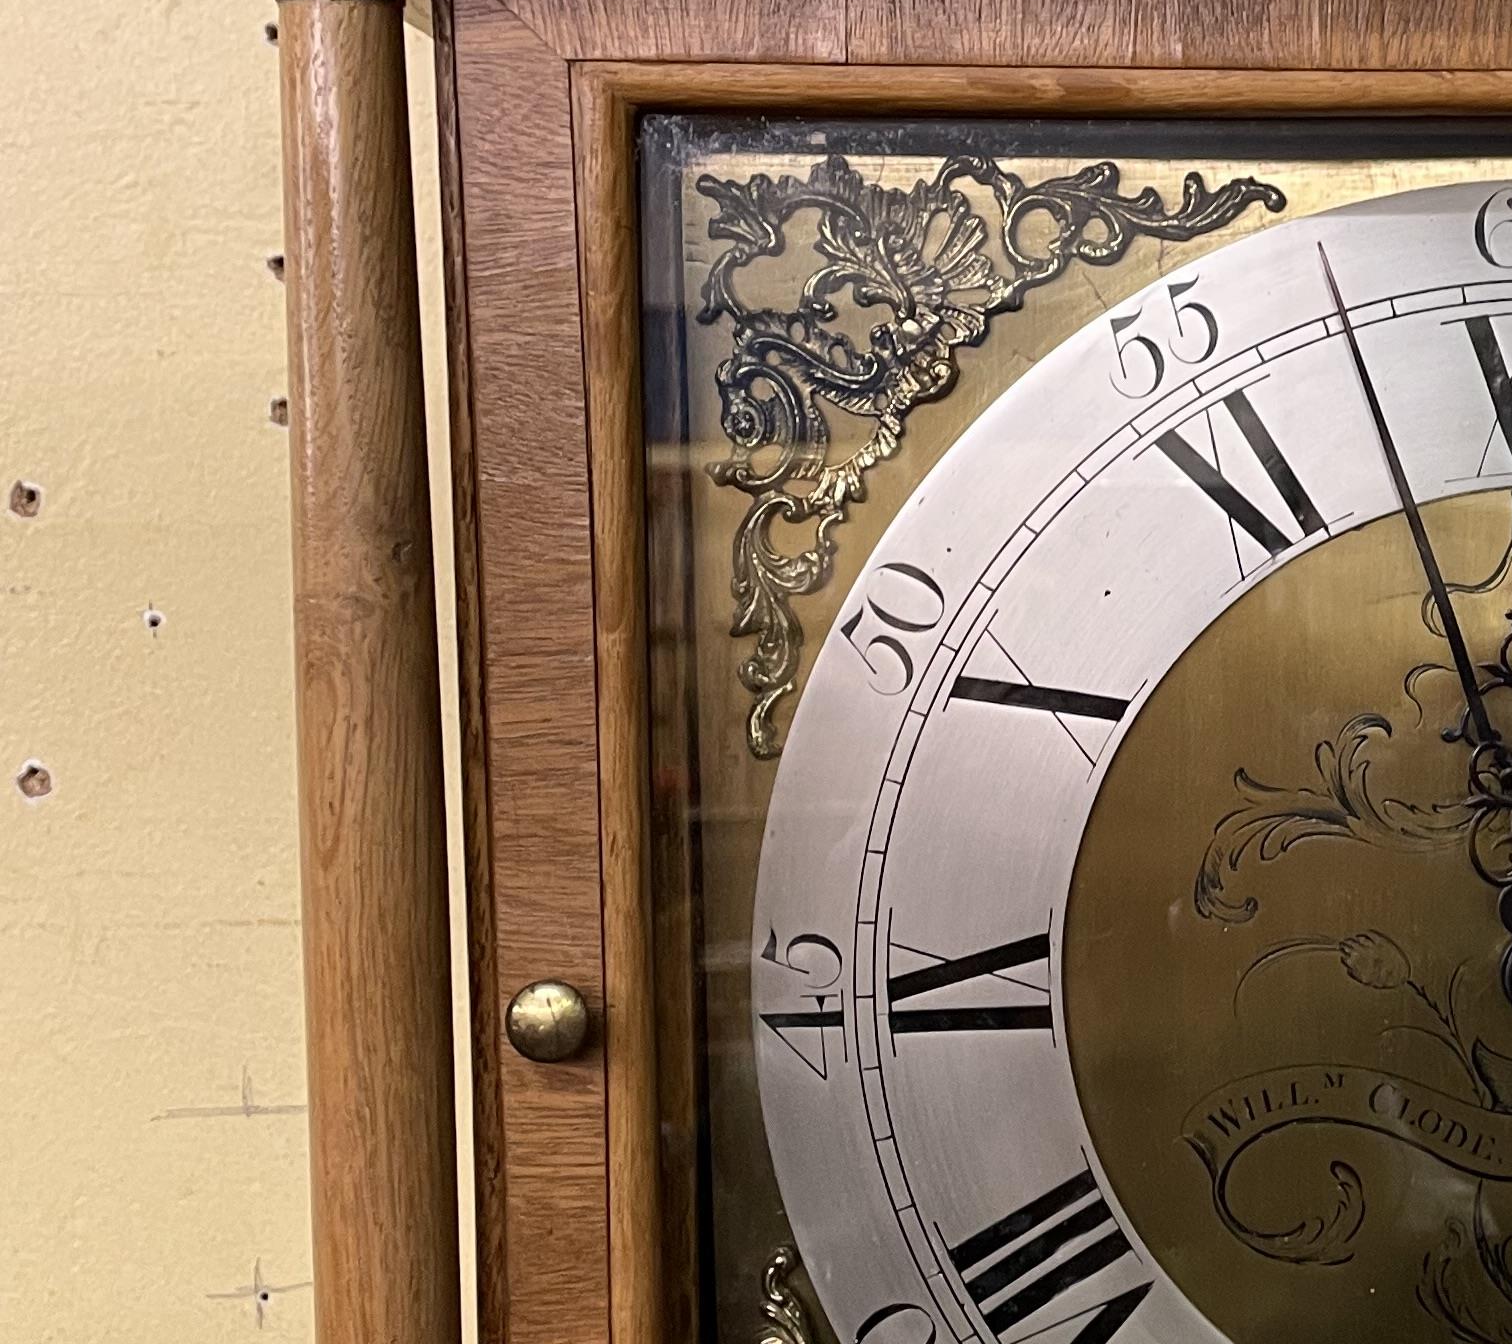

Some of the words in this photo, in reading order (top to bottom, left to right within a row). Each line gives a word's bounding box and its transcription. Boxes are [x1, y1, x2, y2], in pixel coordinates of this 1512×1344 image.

[1109, 274, 1221, 399] 55
[1133, 373, 1354, 598] XI
[840, 563, 946, 696] 50
[943, 609, 1148, 784] X
[759, 920, 849, 1080] 45
[886, 908, 1057, 1058] IX
